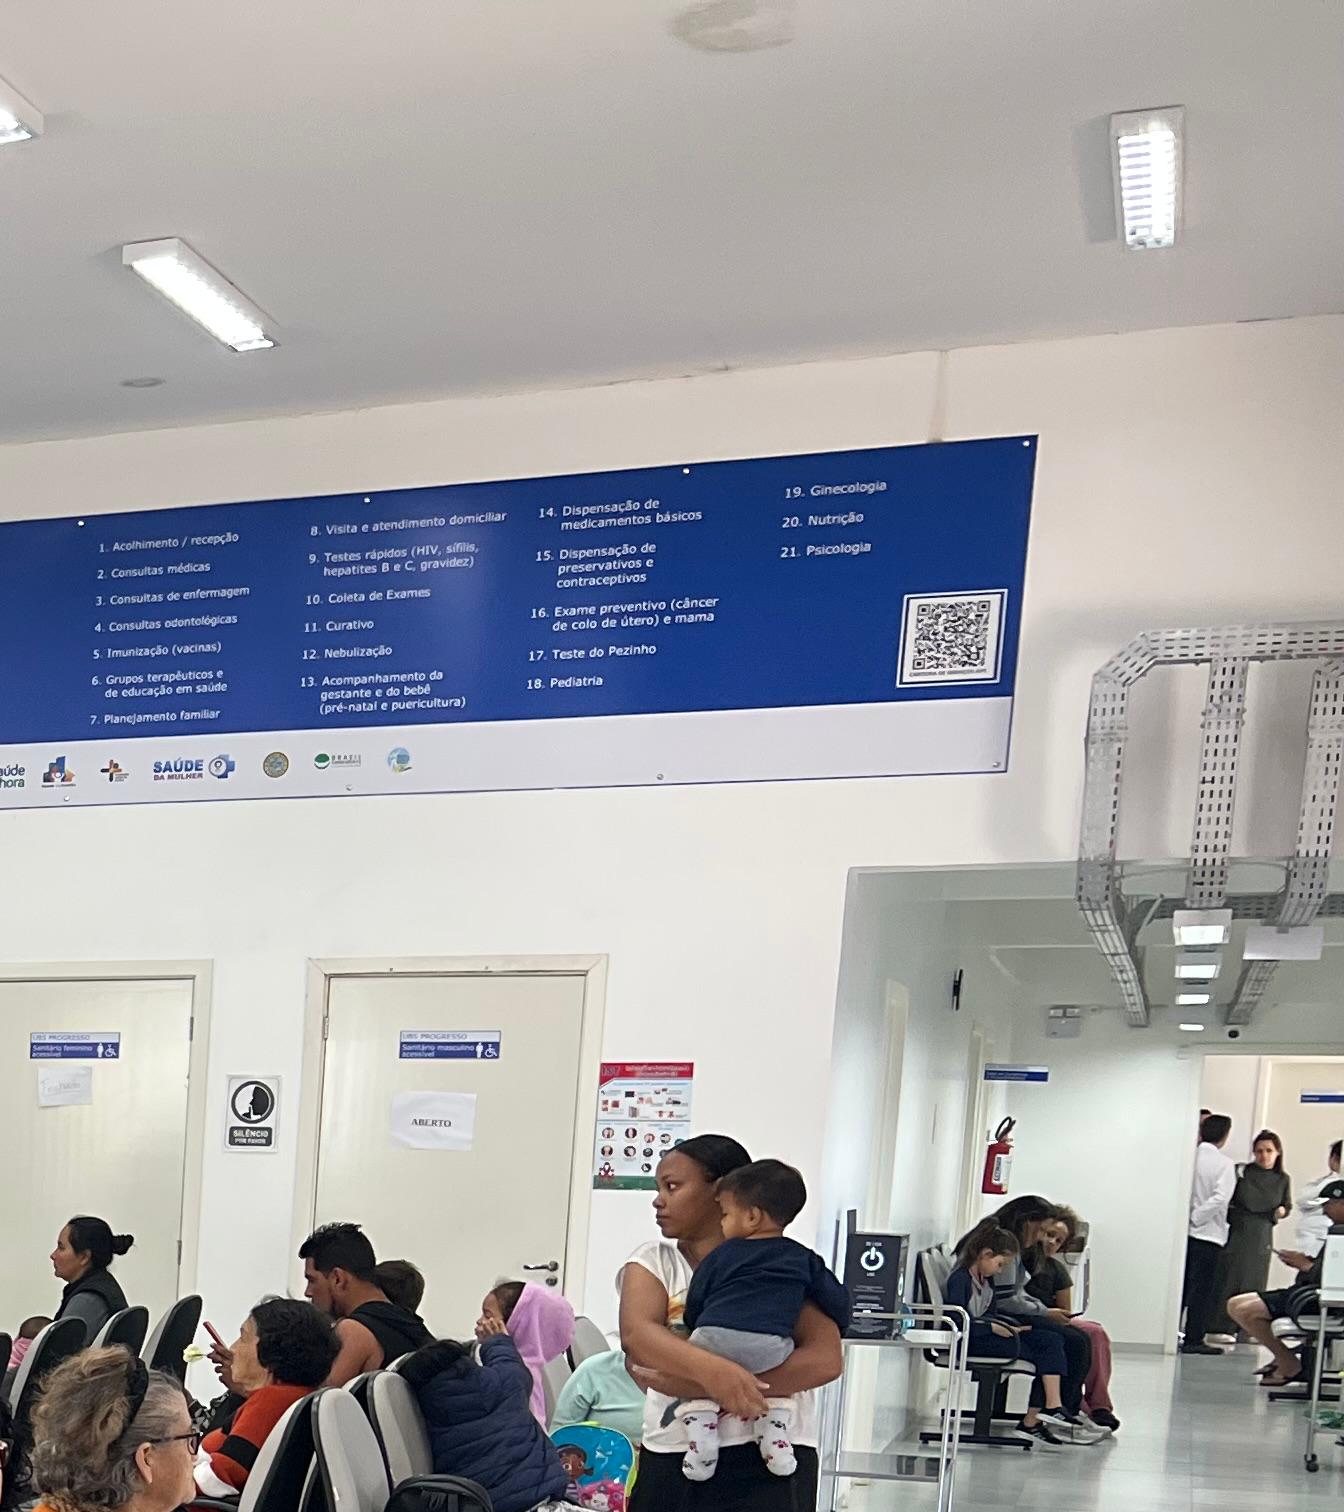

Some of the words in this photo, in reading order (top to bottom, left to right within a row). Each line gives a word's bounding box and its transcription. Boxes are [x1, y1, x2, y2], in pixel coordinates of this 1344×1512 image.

[786, 487, 805, 498] 19.
[810, 481, 887, 496] Ginecologia
[539, 508, 557, 518] 14.
[563, 501, 640, 517] Dispensação
[644, 499, 659, 509] de
[311, 527, 321, 536] 8.
[326, 525, 357, 535] Visita
[372, 517, 445, 531] atendimento
[449, 512, 507, 525] domiciliar
[561, 514, 651, 530] medicamentos
[656, 511, 702, 522] básicos
[782, 517, 803, 528] 20.
[808, 512, 864, 526] Nutrição
[113, 538, 178, 551] Acolhimento
[191, 532, 239, 545] recepção
[309, 554, 319, 564] 9.
[325, 551, 361, 563] Testes
[365, 548, 407, 560] rápidos
[411, 545, 442, 558] (HIV,
[447, 542, 479, 554] sífilis,
[536, 551, 554, 562] 15.
[559, 544, 636, 560] Dispensação
[641, 543, 656, 552] de
[781, 547, 801, 558] 21.
[807, 542, 871, 556] Psicologia
[112, 566, 163, 578] Consultas
[168, 562, 210, 574] médicas
[324, 564, 377, 577] hepatites
[382, 562, 389, 572] B
[394, 564, 400, 572] e
[420, 556, 474, 571] gravidez)
[558, 557, 641, 576] preservativos
[646, 558, 654, 567] e
[556, 573, 647, 589] contraceptivos
[110, 593, 163, 605] Consultas
[167, 592, 180, 601] de
[183, 587, 249, 600] enfermagem
[329, 593, 365, 604] Coleta
[369, 591, 382, 601] de
[387, 588, 431, 600] Exames
[530, 608, 549, 619] 16.
[554, 606, 596, 617] Exame
[600, 601, 666, 615] preventivo
[671, 598, 719, 611] (câncer
[109, 620, 161, 631] Consultas
[165, 615, 237, 627] odontológicas
[326, 620, 374, 631] Curativo
[552, 620, 567, 631] de
[571, 619, 597, 630] colo
[601, 617, 616, 627] de
[621, 614, 659, 627] útero)
[663, 616, 671, 624] e
[675, 612, 714, 623] mama
[107, 645, 168, 658] Imunização
[172, 641, 221, 656] (vacinas)
[302, 650, 319, 659] 12.
[324, 645, 392, 659] Nebulização
[529, 651, 547, 661] 17.
[552, 649, 585, 660] Teste
[589, 648, 604, 657] do
[609, 645, 656, 656] Pezinho
[106, 674, 143, 685] Grupos
[148, 670, 213, 682] terapêuticos
[216, 670, 223, 678] e
[301, 677, 317, 687] 13.
[322, 671, 425, 686] Acompanhamento
[429, 670, 443, 681] da
[527, 679, 545, 689] 18.
[550, 676, 603, 688] Pediatria
[105, 688, 117, 698] de
[122, 685, 172, 697] educação
[176, 685, 192, 694] em
[196, 682, 227, 692] saúde
[321, 689, 371, 701] gestante
[386, 687, 400, 696] do
[404, 683, 431, 695] bebê
[320, 700, 377, 715] (pré-natal
[392, 696, 466, 711] puericultura)
[104, 711, 176, 725] Planejamento
[180, 709, 221, 720] familiar
[153, 757, 204, 774] SAÚDE
[0, 778, 24, 788] hora
[167, 772, 203, 780] MULHER
[412, 1119, 451, 1127] ABERTO
[233, 1129, 268, 1137] SILÊNCIO
